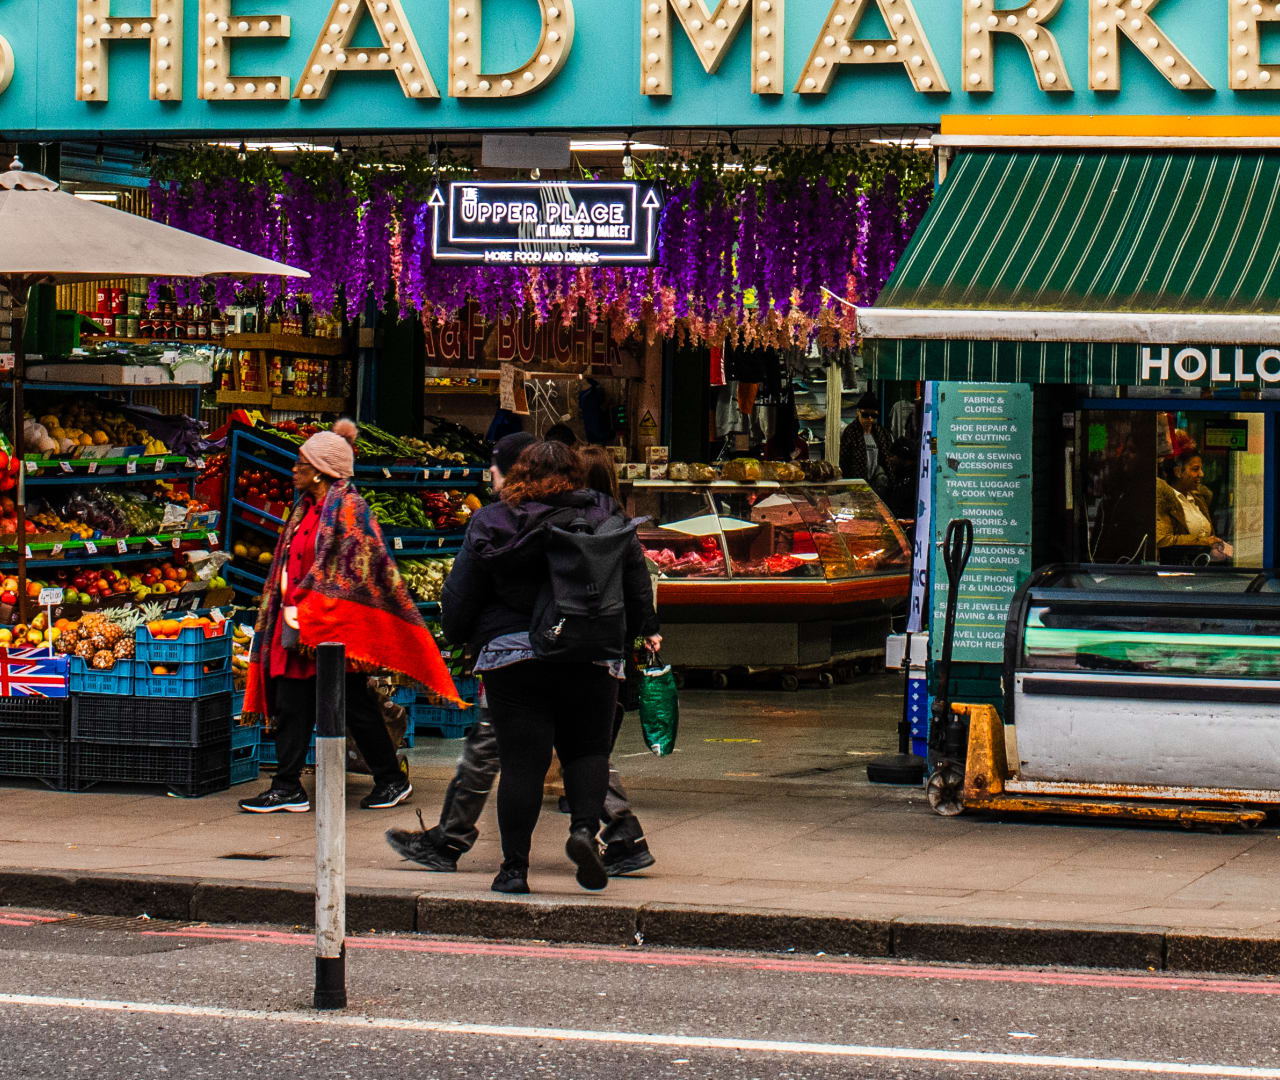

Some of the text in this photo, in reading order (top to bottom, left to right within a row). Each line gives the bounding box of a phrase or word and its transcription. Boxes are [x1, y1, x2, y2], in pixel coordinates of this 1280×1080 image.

[461, 201, 625, 224] UPPER PLACE
[596, 225, 631, 238] MARKET
[484, 251, 600, 262] MORE FOOD AND DRINKS
[964, 396, 1005, 404] FABRIC &
[950, 424, 1018, 433] SHOE REPAIR &
[956, 433, 973, 441] KEY
[945, 452, 1022, 460] TAILOR & SEWING
[980, 481, 1021, 489] LUGGAGE
[952, 489, 960, 497] &
[988, 490, 1015, 498] WEAR
[962, 508, 1004, 516] SMOKING
[989, 557, 1020, 565] CARDS
[983, 575, 1015, 583] PHONE
[968, 584, 976, 592] &
[987, 612, 995, 620] &
[952, 640, 984, 648] WATCH
